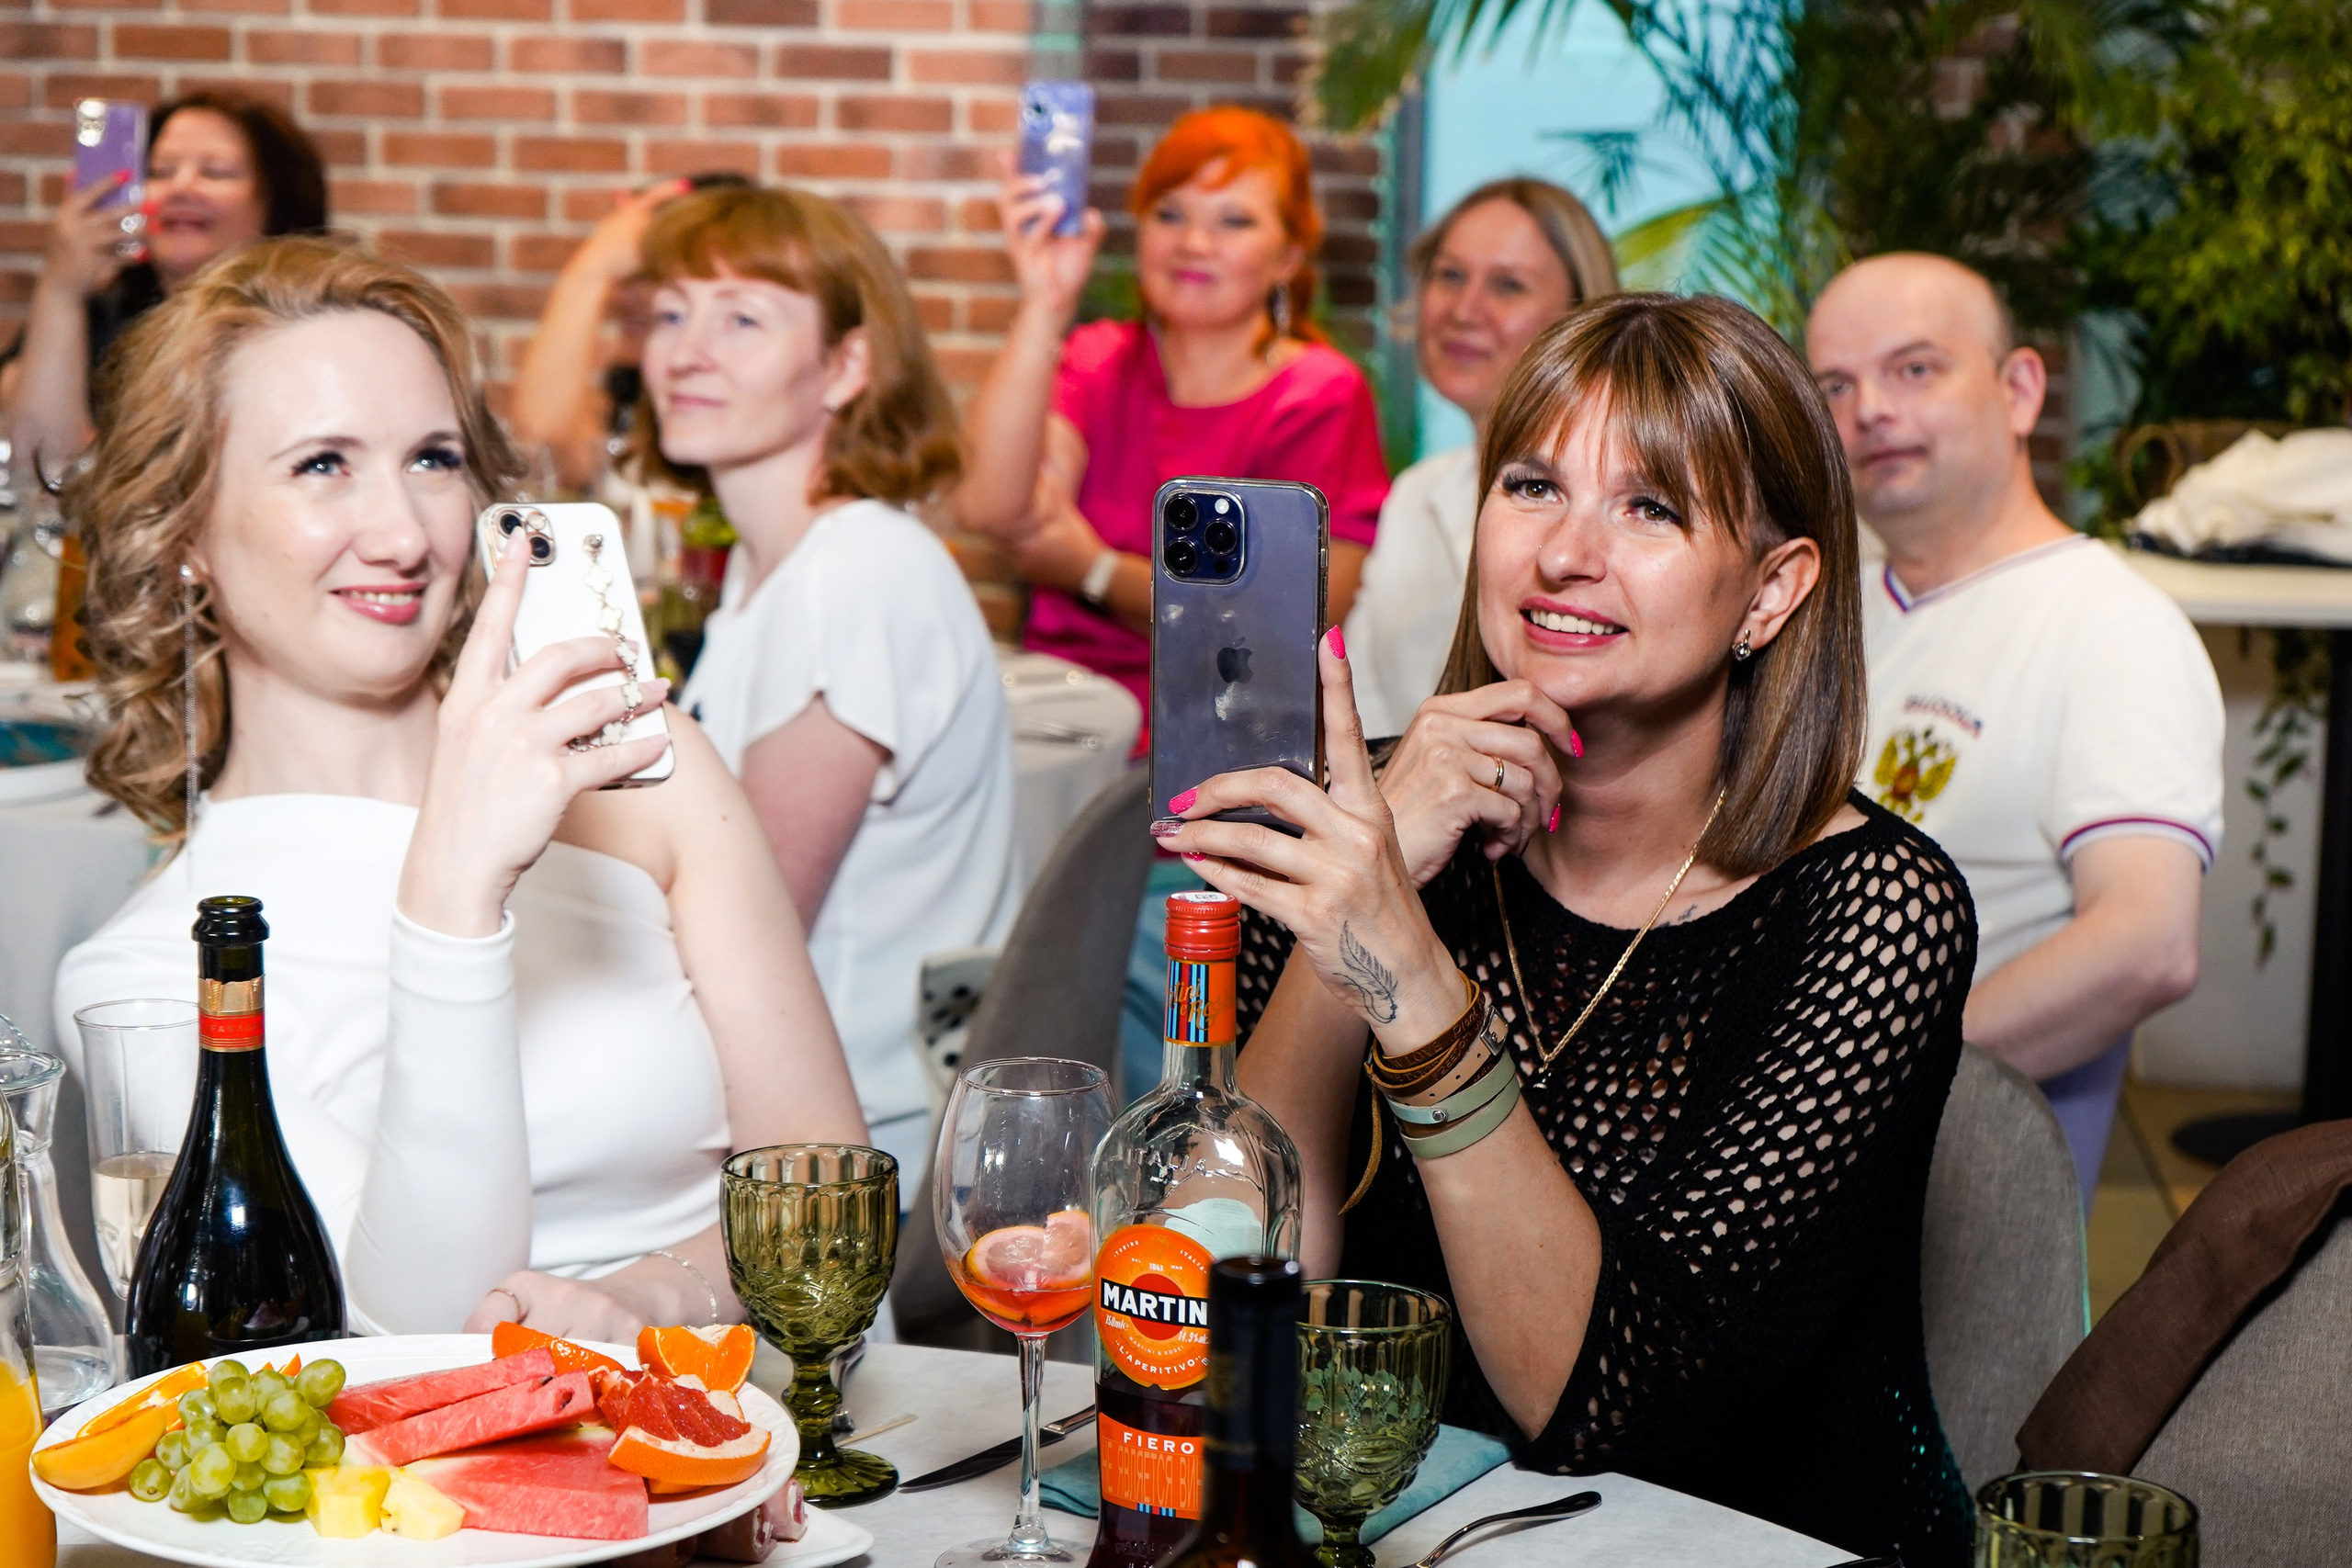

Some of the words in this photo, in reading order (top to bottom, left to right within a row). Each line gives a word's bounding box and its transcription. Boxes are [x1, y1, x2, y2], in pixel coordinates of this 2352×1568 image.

[1114, 1240, 1139, 1257] TORINO
[1149, 1262, 1164, 1271] 1863
[1180, 1249, 1204, 1271] ITALIA
[1103, 1282, 1208, 1325] MARTIN
[1128, 1336, 1155, 1355] MARTINI
[1118, 1345, 1195, 1374] L'APERITIVO
[1123, 1431, 1194, 1454] FIERO
[1117, 1445, 1173, 1506] ЯВЛЯЕТСЯ
[1179, 1456, 1203, 1509] ВИН
